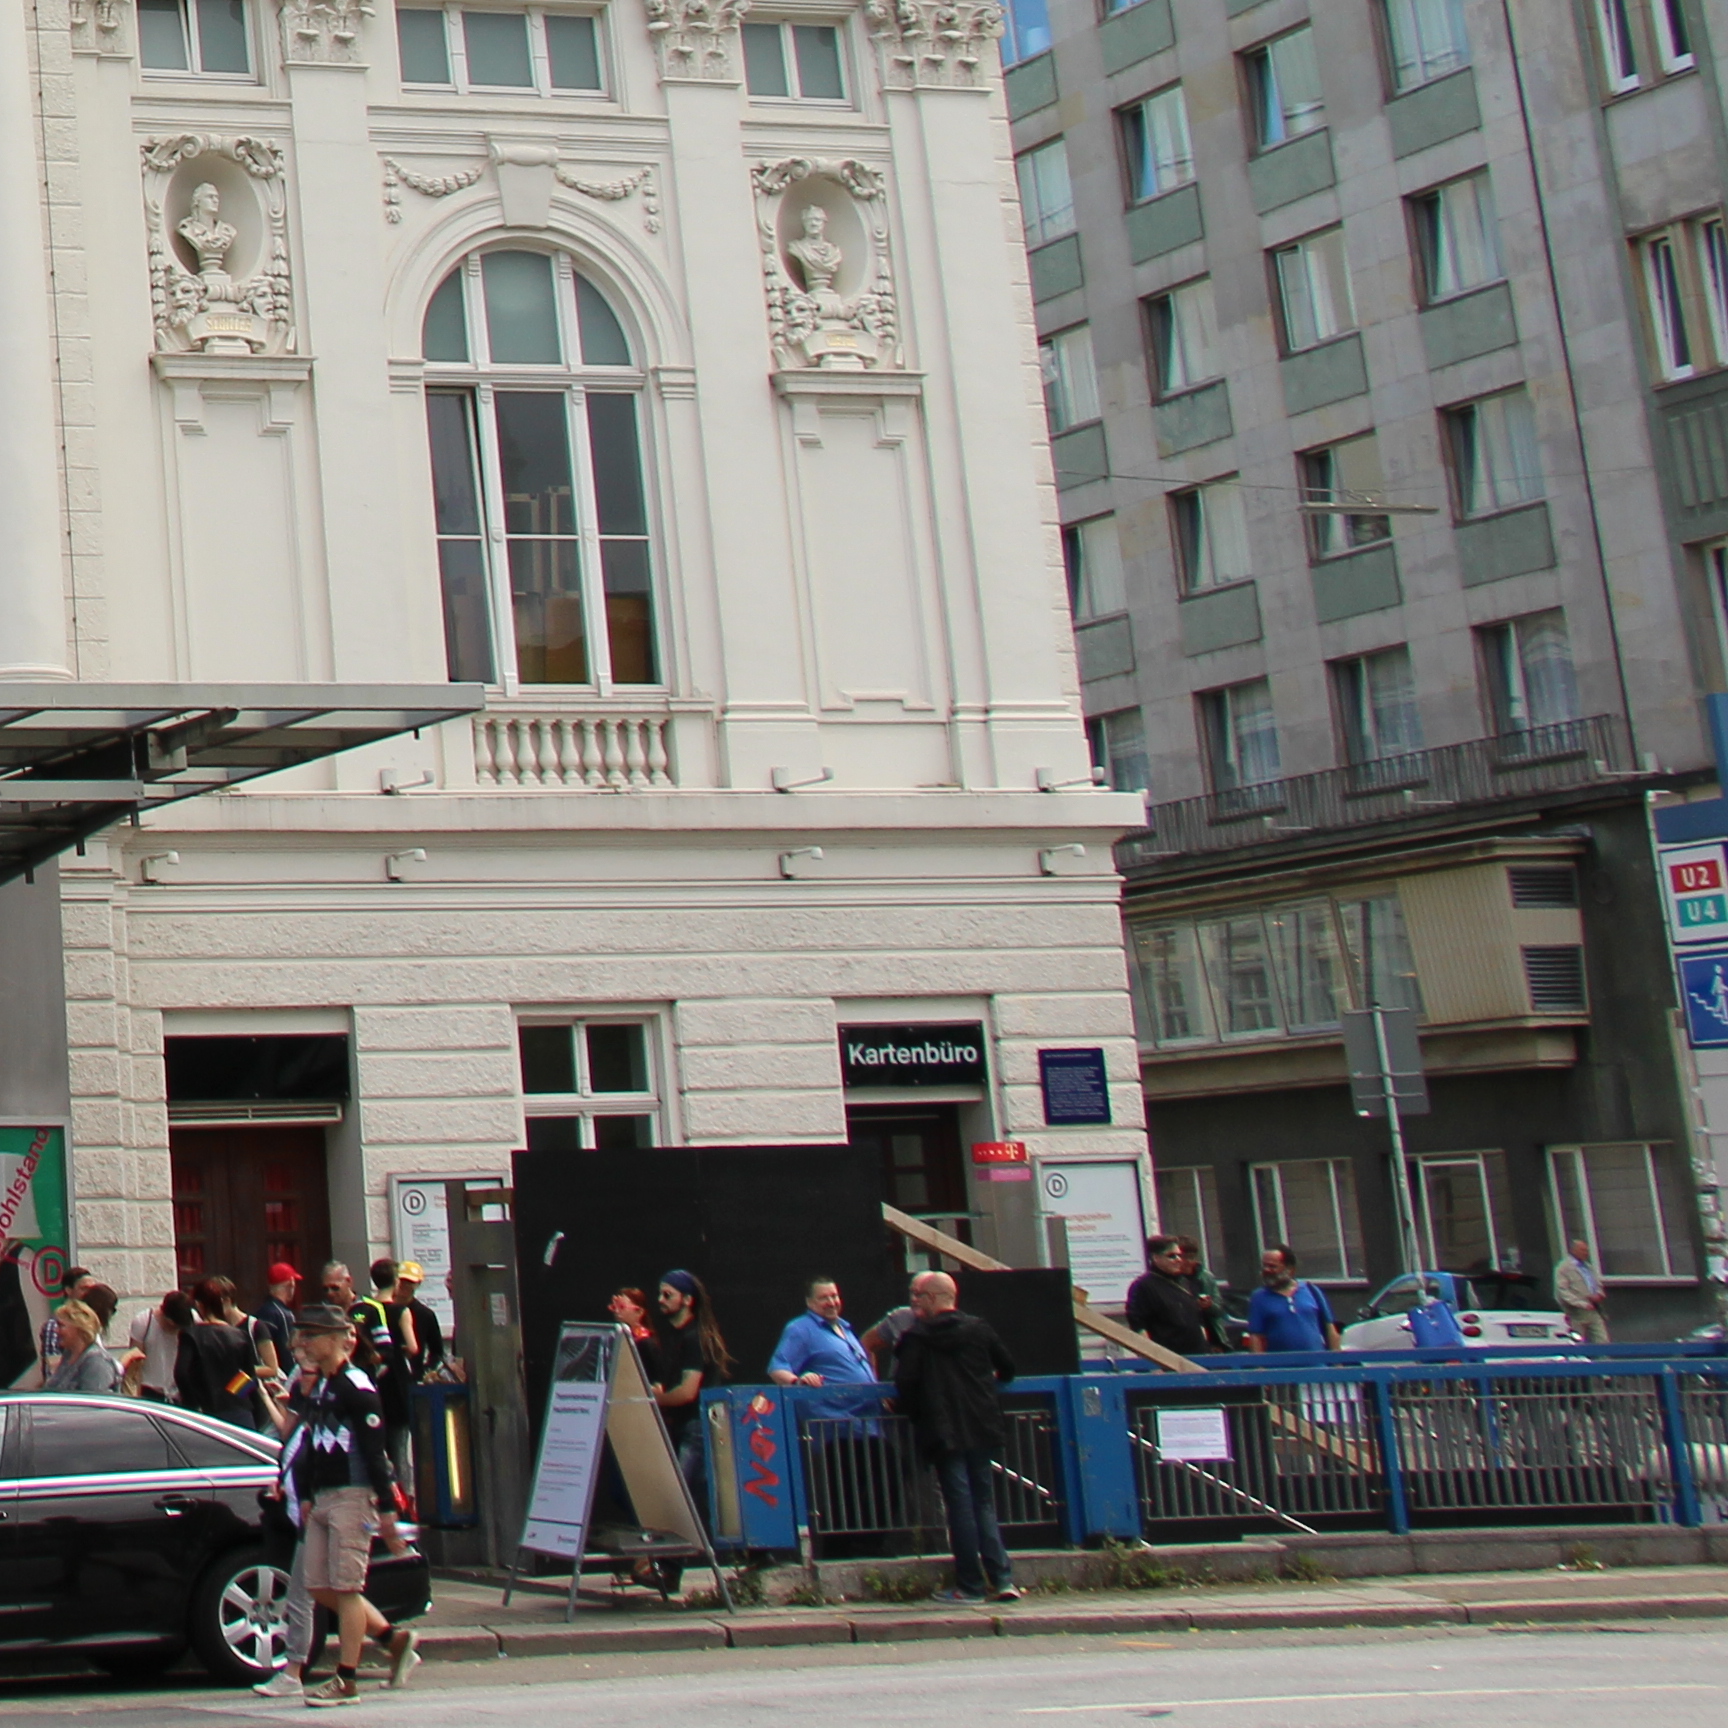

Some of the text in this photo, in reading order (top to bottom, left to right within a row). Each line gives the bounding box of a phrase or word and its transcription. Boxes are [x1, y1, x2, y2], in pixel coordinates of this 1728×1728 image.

[1681, 865, 1710, 888] U2
[1687, 898, 1718, 921] U4
[848, 1041, 978, 1066] Kartenbüro
